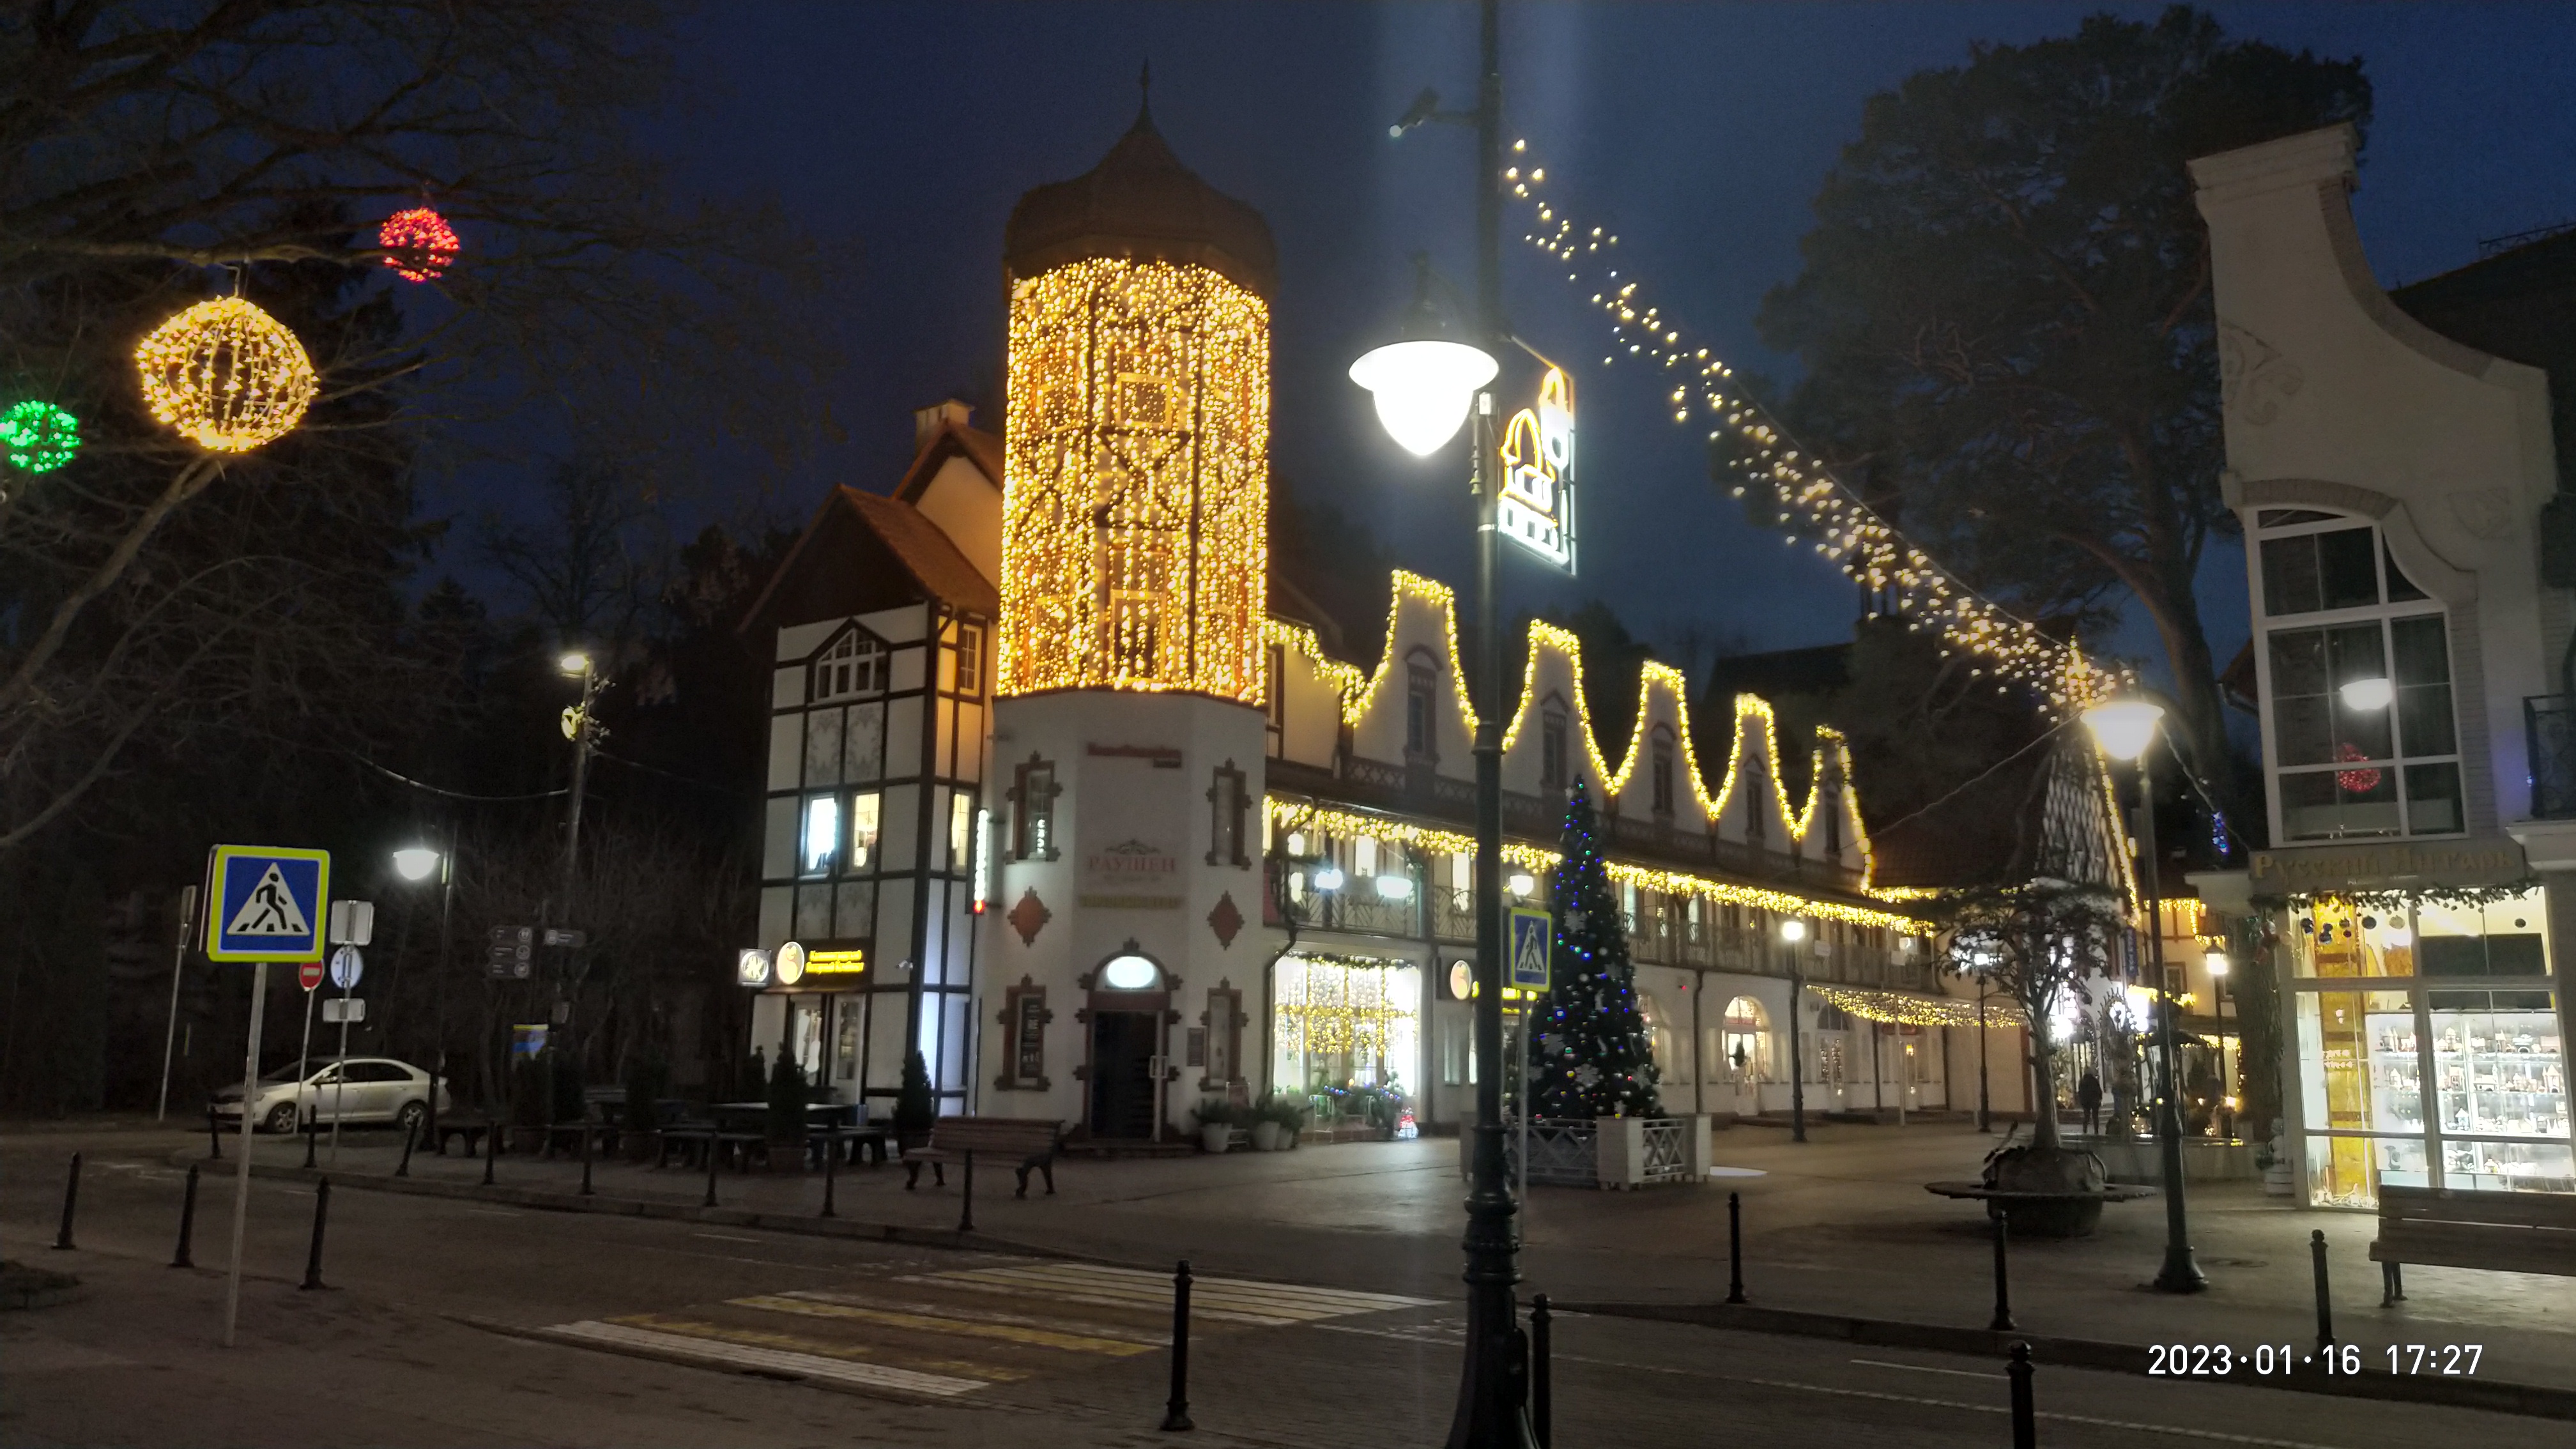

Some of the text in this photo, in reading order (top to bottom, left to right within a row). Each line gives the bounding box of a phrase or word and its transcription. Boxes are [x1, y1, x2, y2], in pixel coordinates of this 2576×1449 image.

[1087, 855, 1176, 871] РАУШЕН
[2253, 847, 2515, 886] Русский Янтарь
